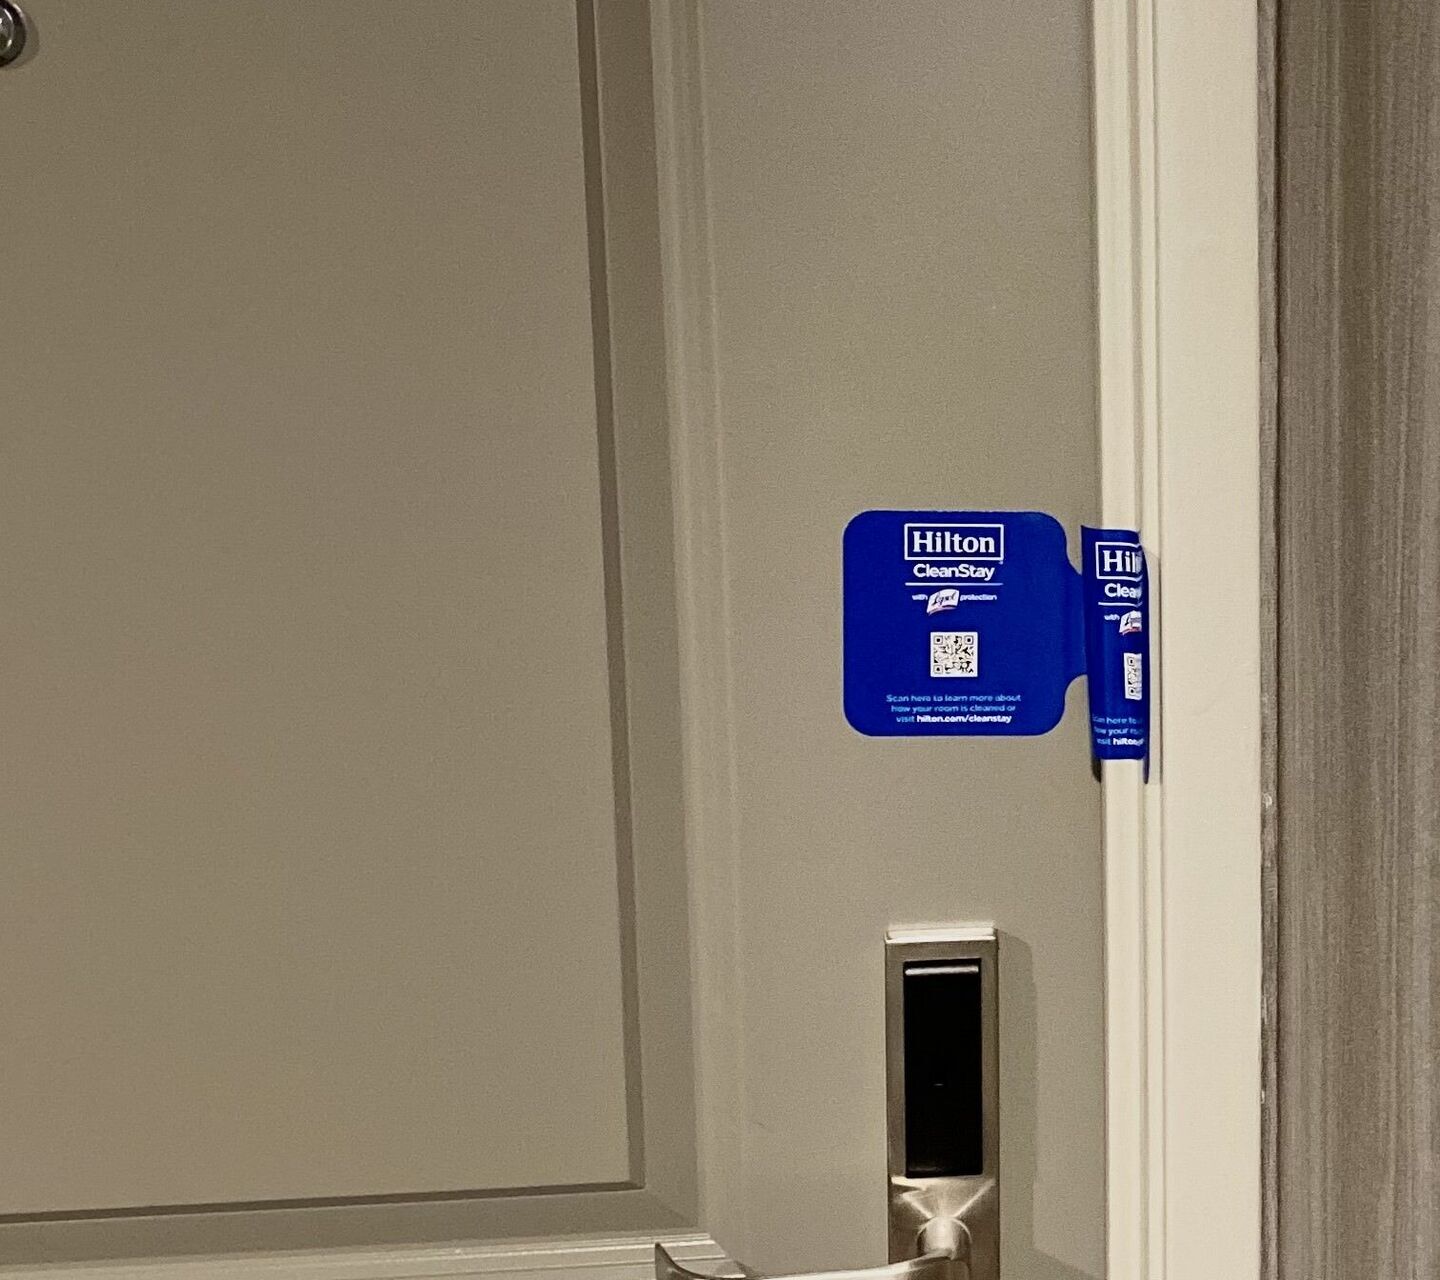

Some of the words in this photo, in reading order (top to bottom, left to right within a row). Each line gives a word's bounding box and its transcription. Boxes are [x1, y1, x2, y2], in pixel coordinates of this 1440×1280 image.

[913, 531, 995, 553] Hilton
[913, 563, 995, 581] CleanStay
[886, 694, 909, 702] Scan
[911, 694, 931, 702] here
[933, 694, 944, 702] to
[945, 694, 968, 702] learn
[969, 694, 993, 702] more
[995, 694, 1021, 702] about
[912, 705, 932, 714] your
[961, 704, 968, 712] is
[970, 704, 1005, 712] cleaned
[896, 715, 915, 723] visit
[916, 714, 1012, 724] hilton.com/cleanstay
